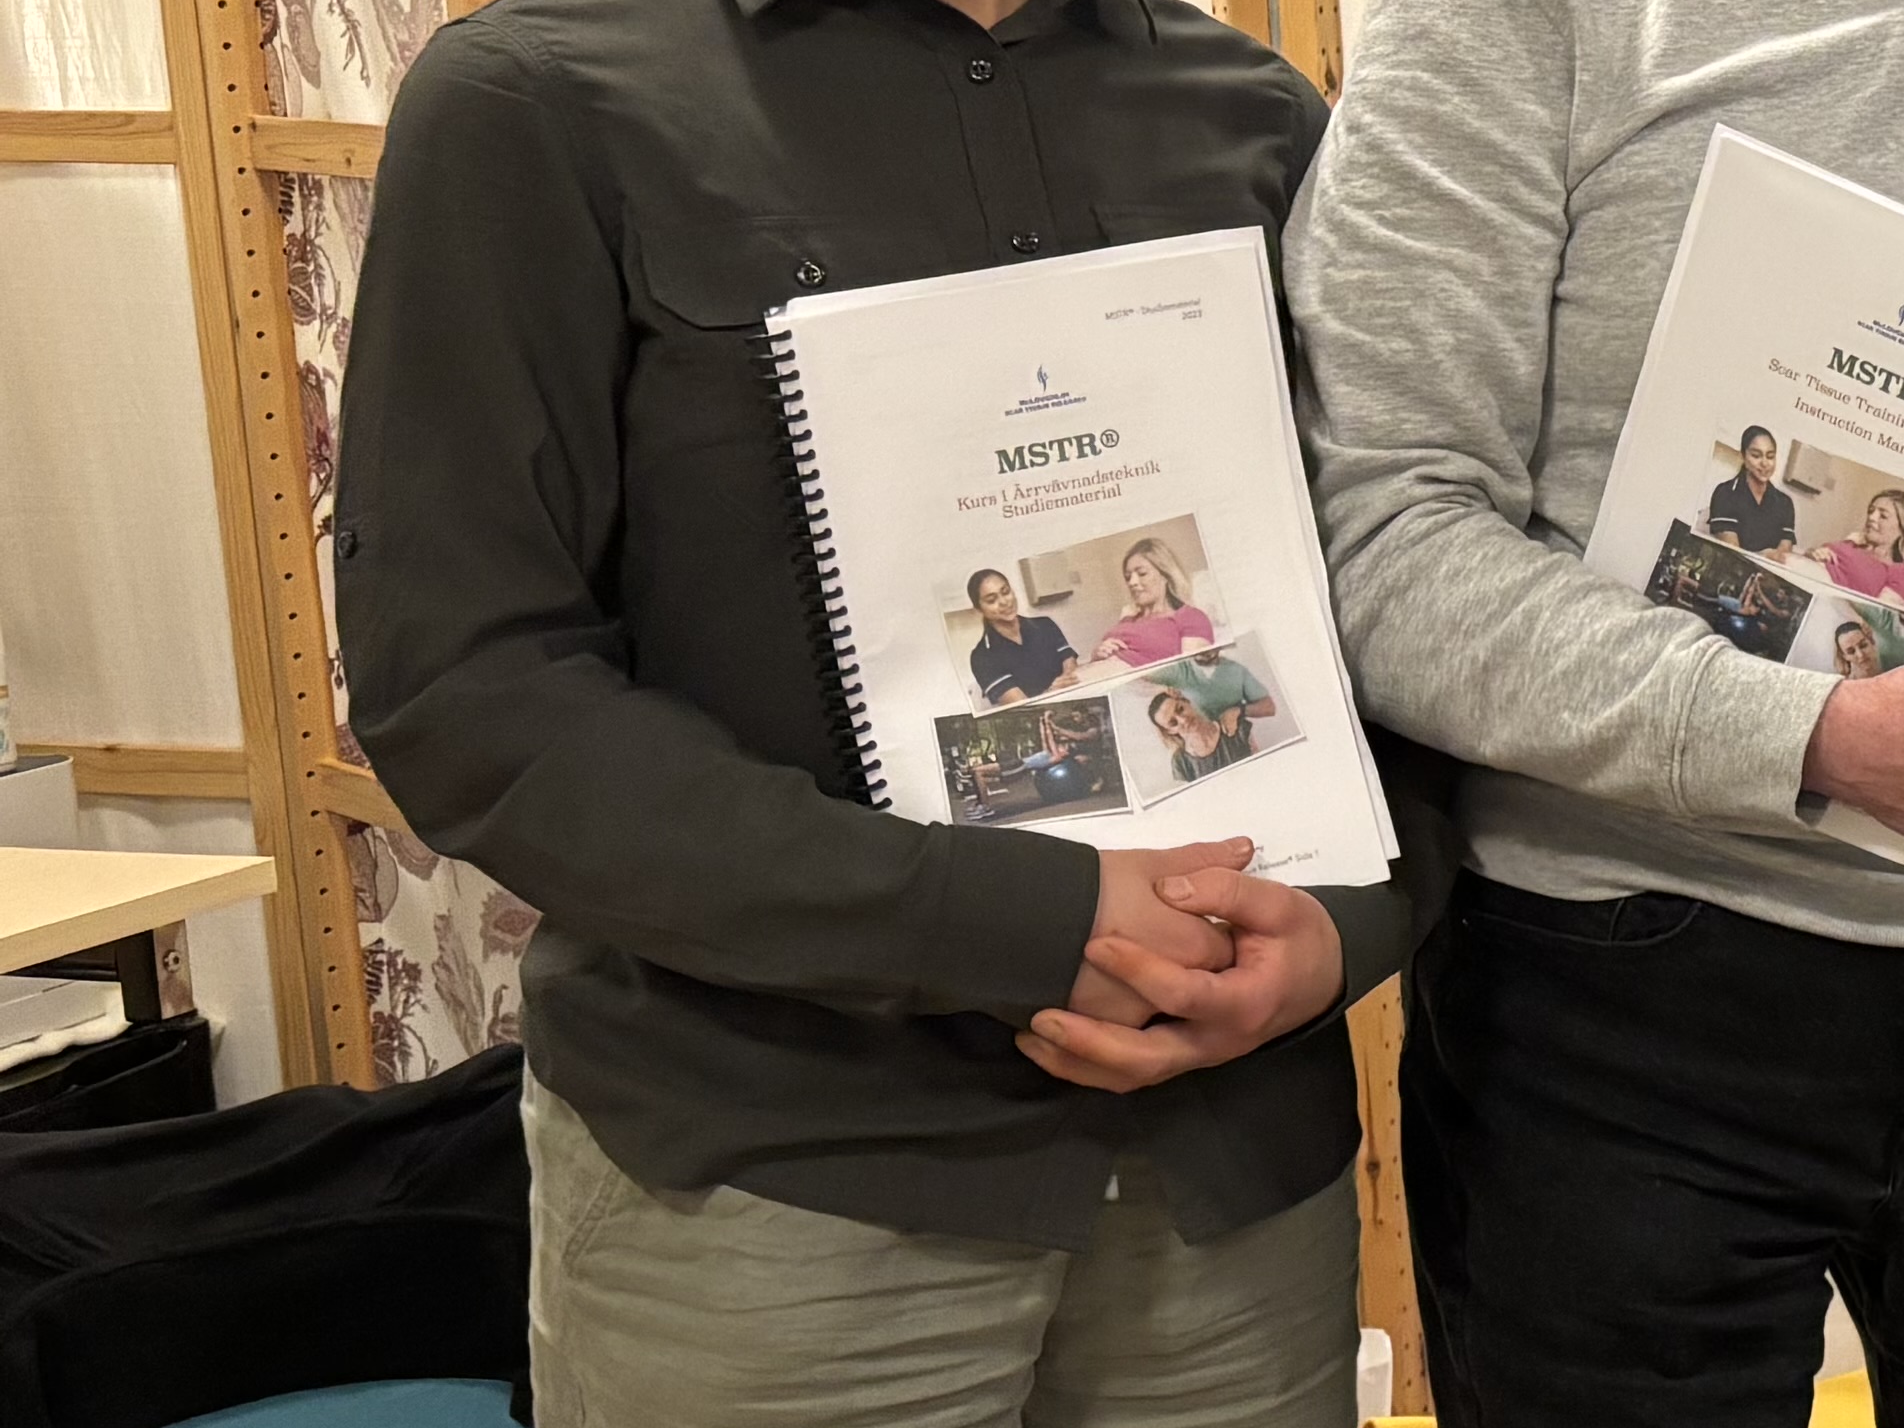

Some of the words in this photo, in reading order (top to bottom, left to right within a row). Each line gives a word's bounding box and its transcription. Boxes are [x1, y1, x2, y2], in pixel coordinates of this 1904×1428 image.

[1768, 357, 1801, 382] Scar
[1805, 373, 1852, 405] Tissue
[1793, 396, 1873, 442] Instruction
[956, 494, 998, 512] Kurs
[1001, 482, 1123, 519] Studiematerial
